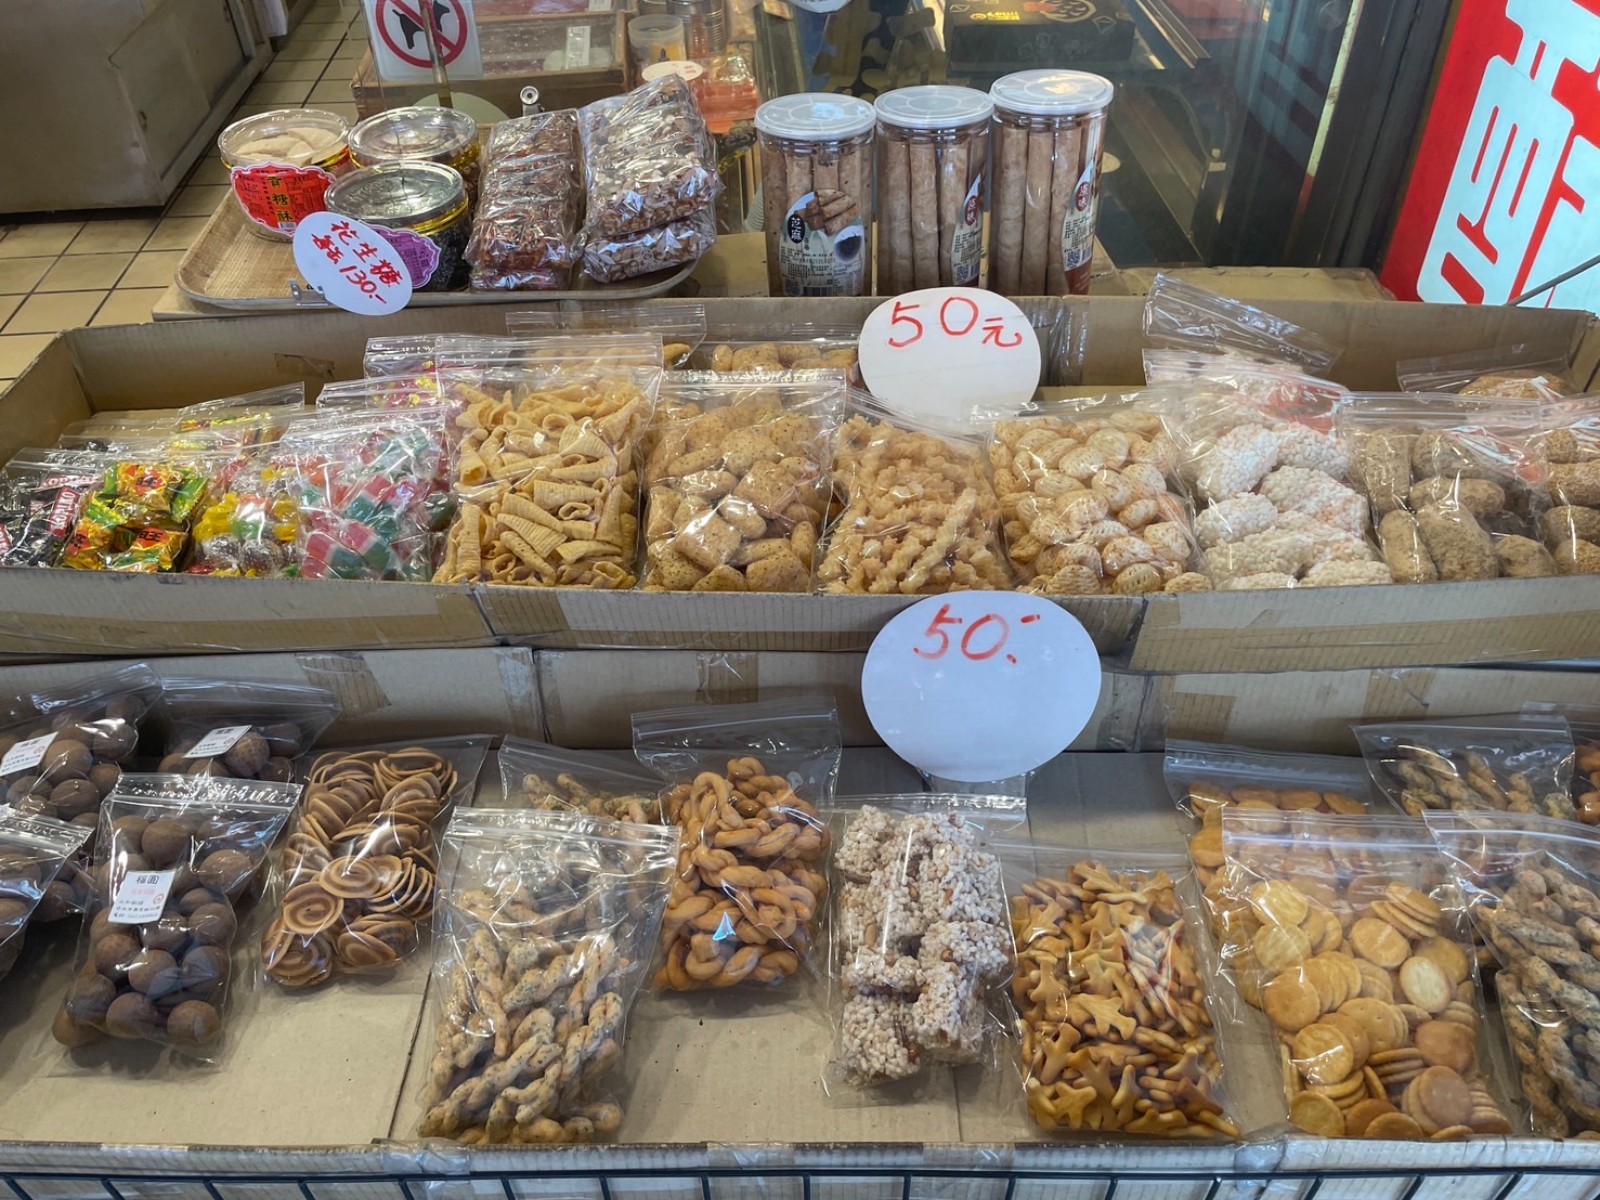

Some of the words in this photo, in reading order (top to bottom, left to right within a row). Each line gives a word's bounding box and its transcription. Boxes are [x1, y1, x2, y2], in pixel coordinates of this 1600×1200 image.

[330, 220, 403, 288] 花生糖
[887, 296, 1023, 348] 50元
[50, 491, 77, 530] KOPIKO
